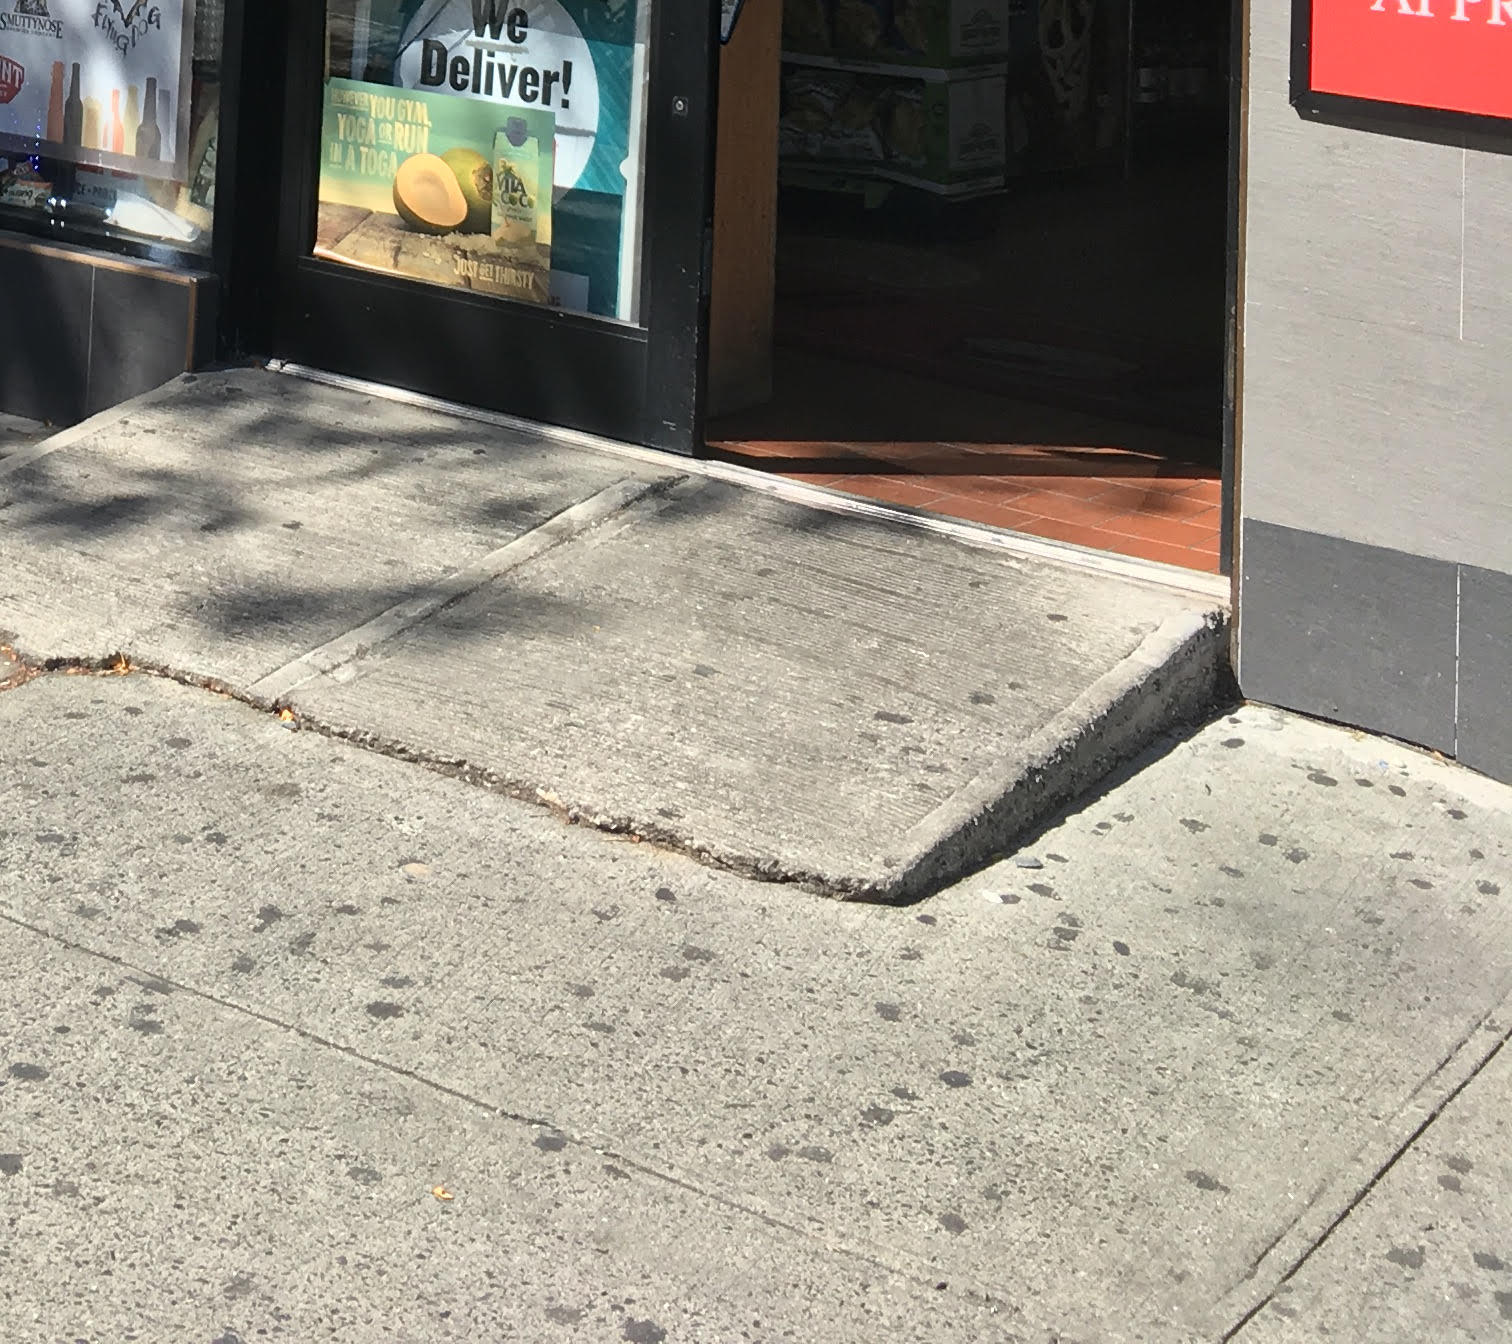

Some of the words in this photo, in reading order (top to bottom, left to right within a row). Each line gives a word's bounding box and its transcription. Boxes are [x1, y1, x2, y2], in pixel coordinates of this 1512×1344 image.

[419, 36, 573, 111] Deliver!
[369, 93, 397, 121] YOU
[336, 112, 376, 146] YOGA
[378, 122, 394, 143] OR
[393, 120, 431, 154] RUN
[344, 143, 356, 172] A
[359, 145, 399, 177] TOGA
[496, 172, 529, 198] VITA
[499, 191, 536, 210] COCO
[452, 254, 479, 280] JUST
[479, 262, 495, 280] GET
[494, 264, 536, 292] THIRSTY
